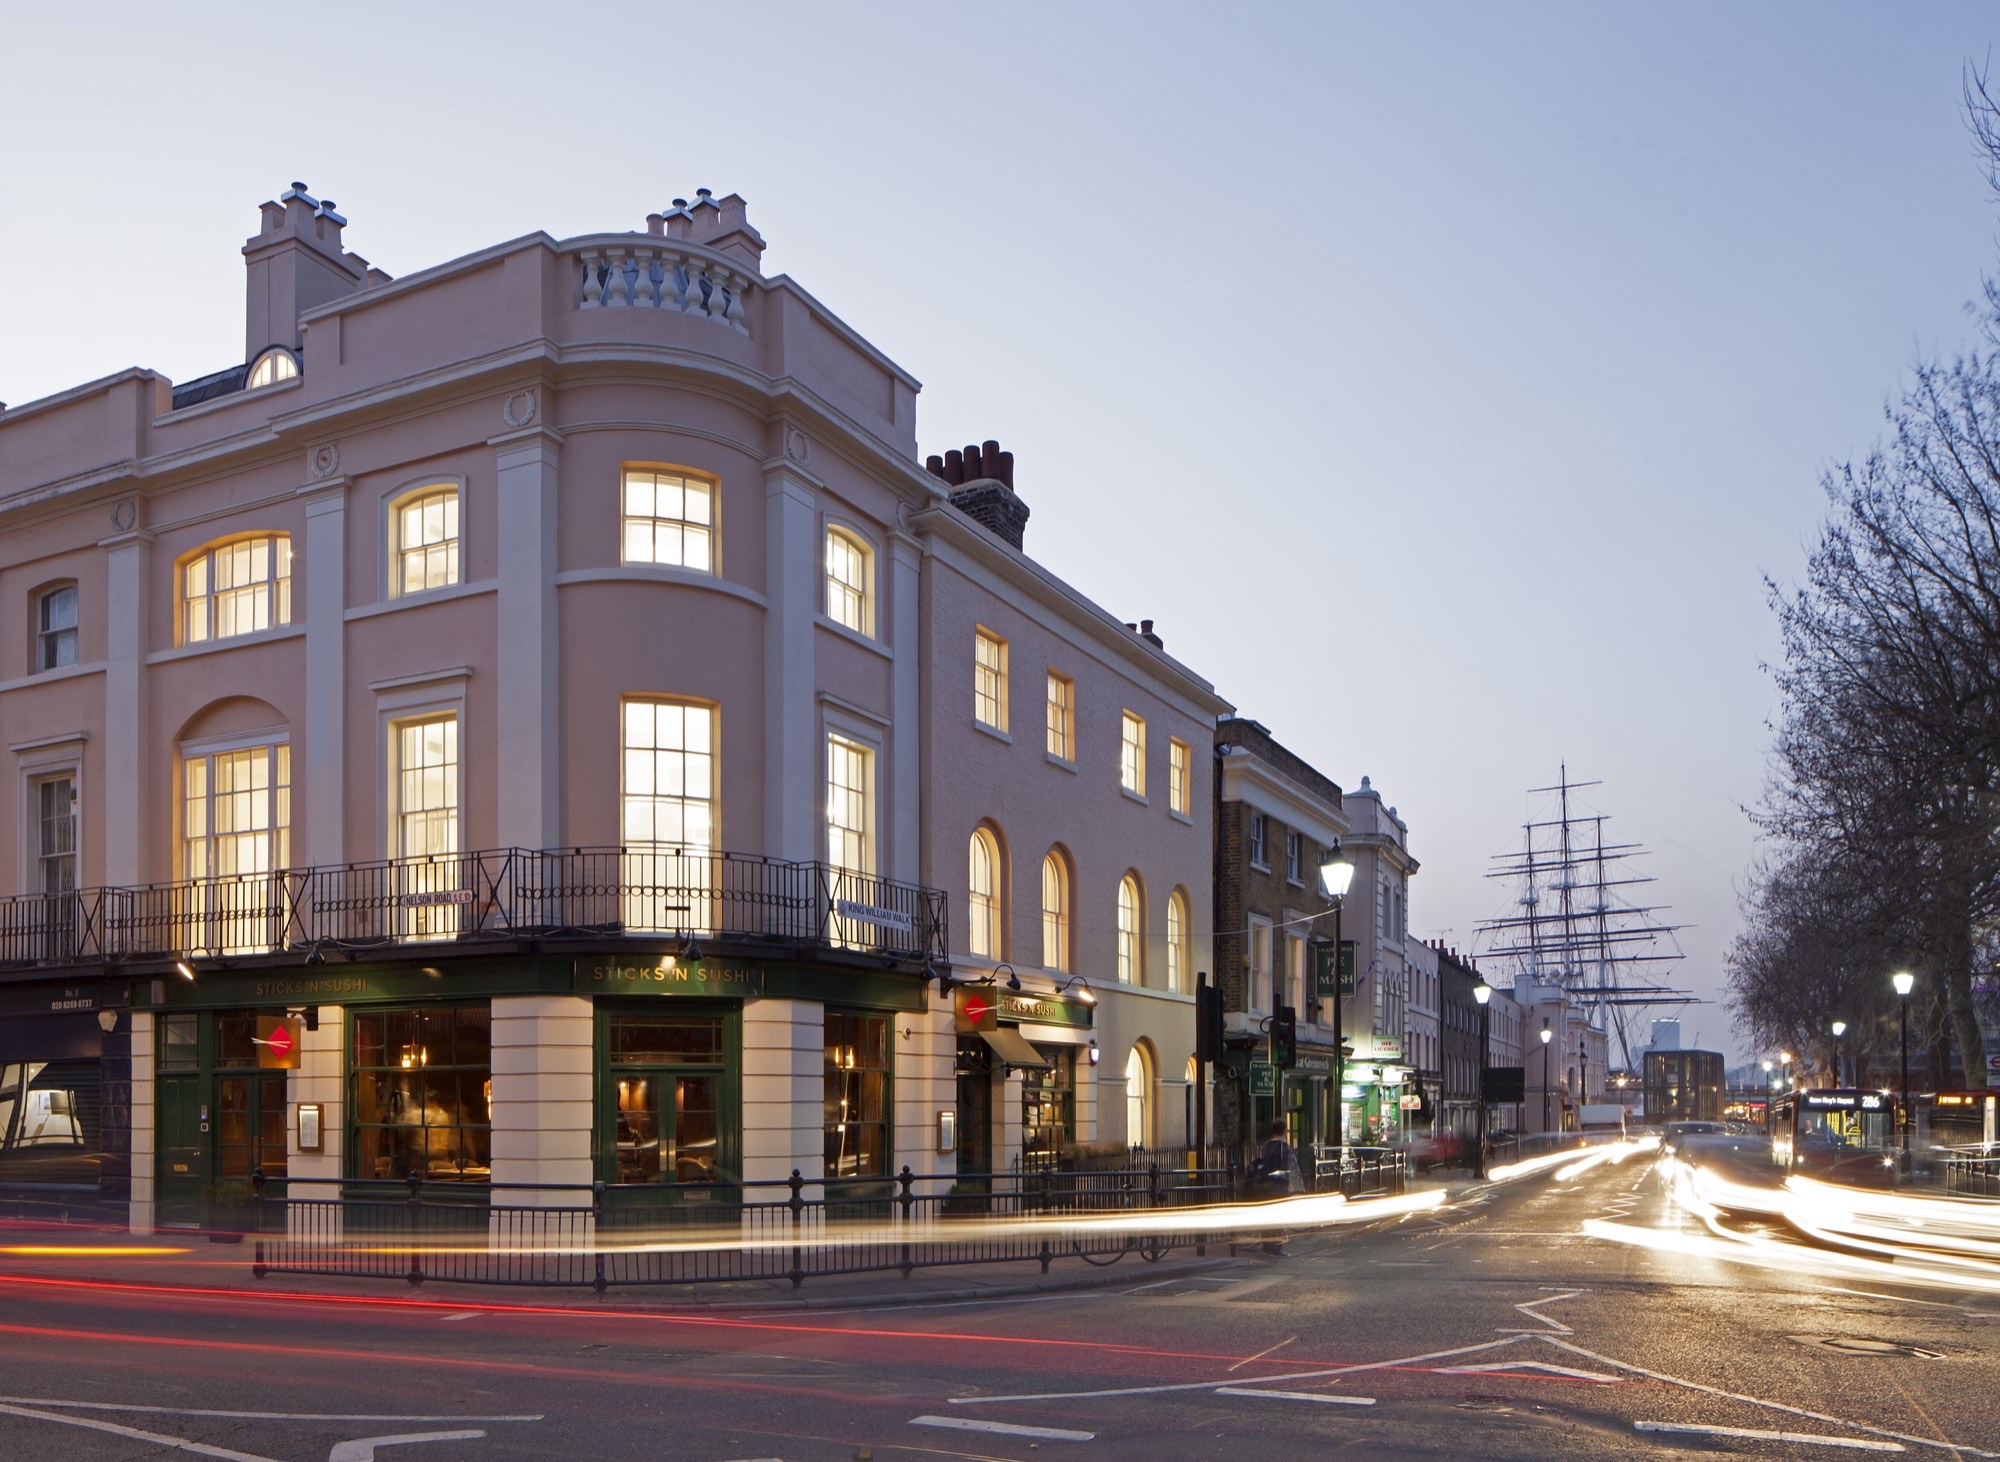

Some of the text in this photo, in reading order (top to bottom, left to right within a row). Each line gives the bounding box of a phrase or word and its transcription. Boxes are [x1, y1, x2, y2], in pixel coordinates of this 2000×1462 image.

[406, 895, 432, 906] NELSON
[848, 903, 864, 915] KING
[865, 908, 892, 921] WILLIAM
[892, 913, 911, 925] WALK
[1327, 957, 1345, 967] PE
[593, 966, 665, 981] STICKS
[697, 968, 750, 983] SUSHI
[256, 980, 304, 996] STICKS
[324, 978, 368, 992] SUSHI
[51, 999, 92, 1010] 020 8269 0737
[1001, 1000, 1027, 1013] STICKS
[1036, 1004, 1057, 1017] SUSHI
[1862, 1095, 1880, 1108] 286
